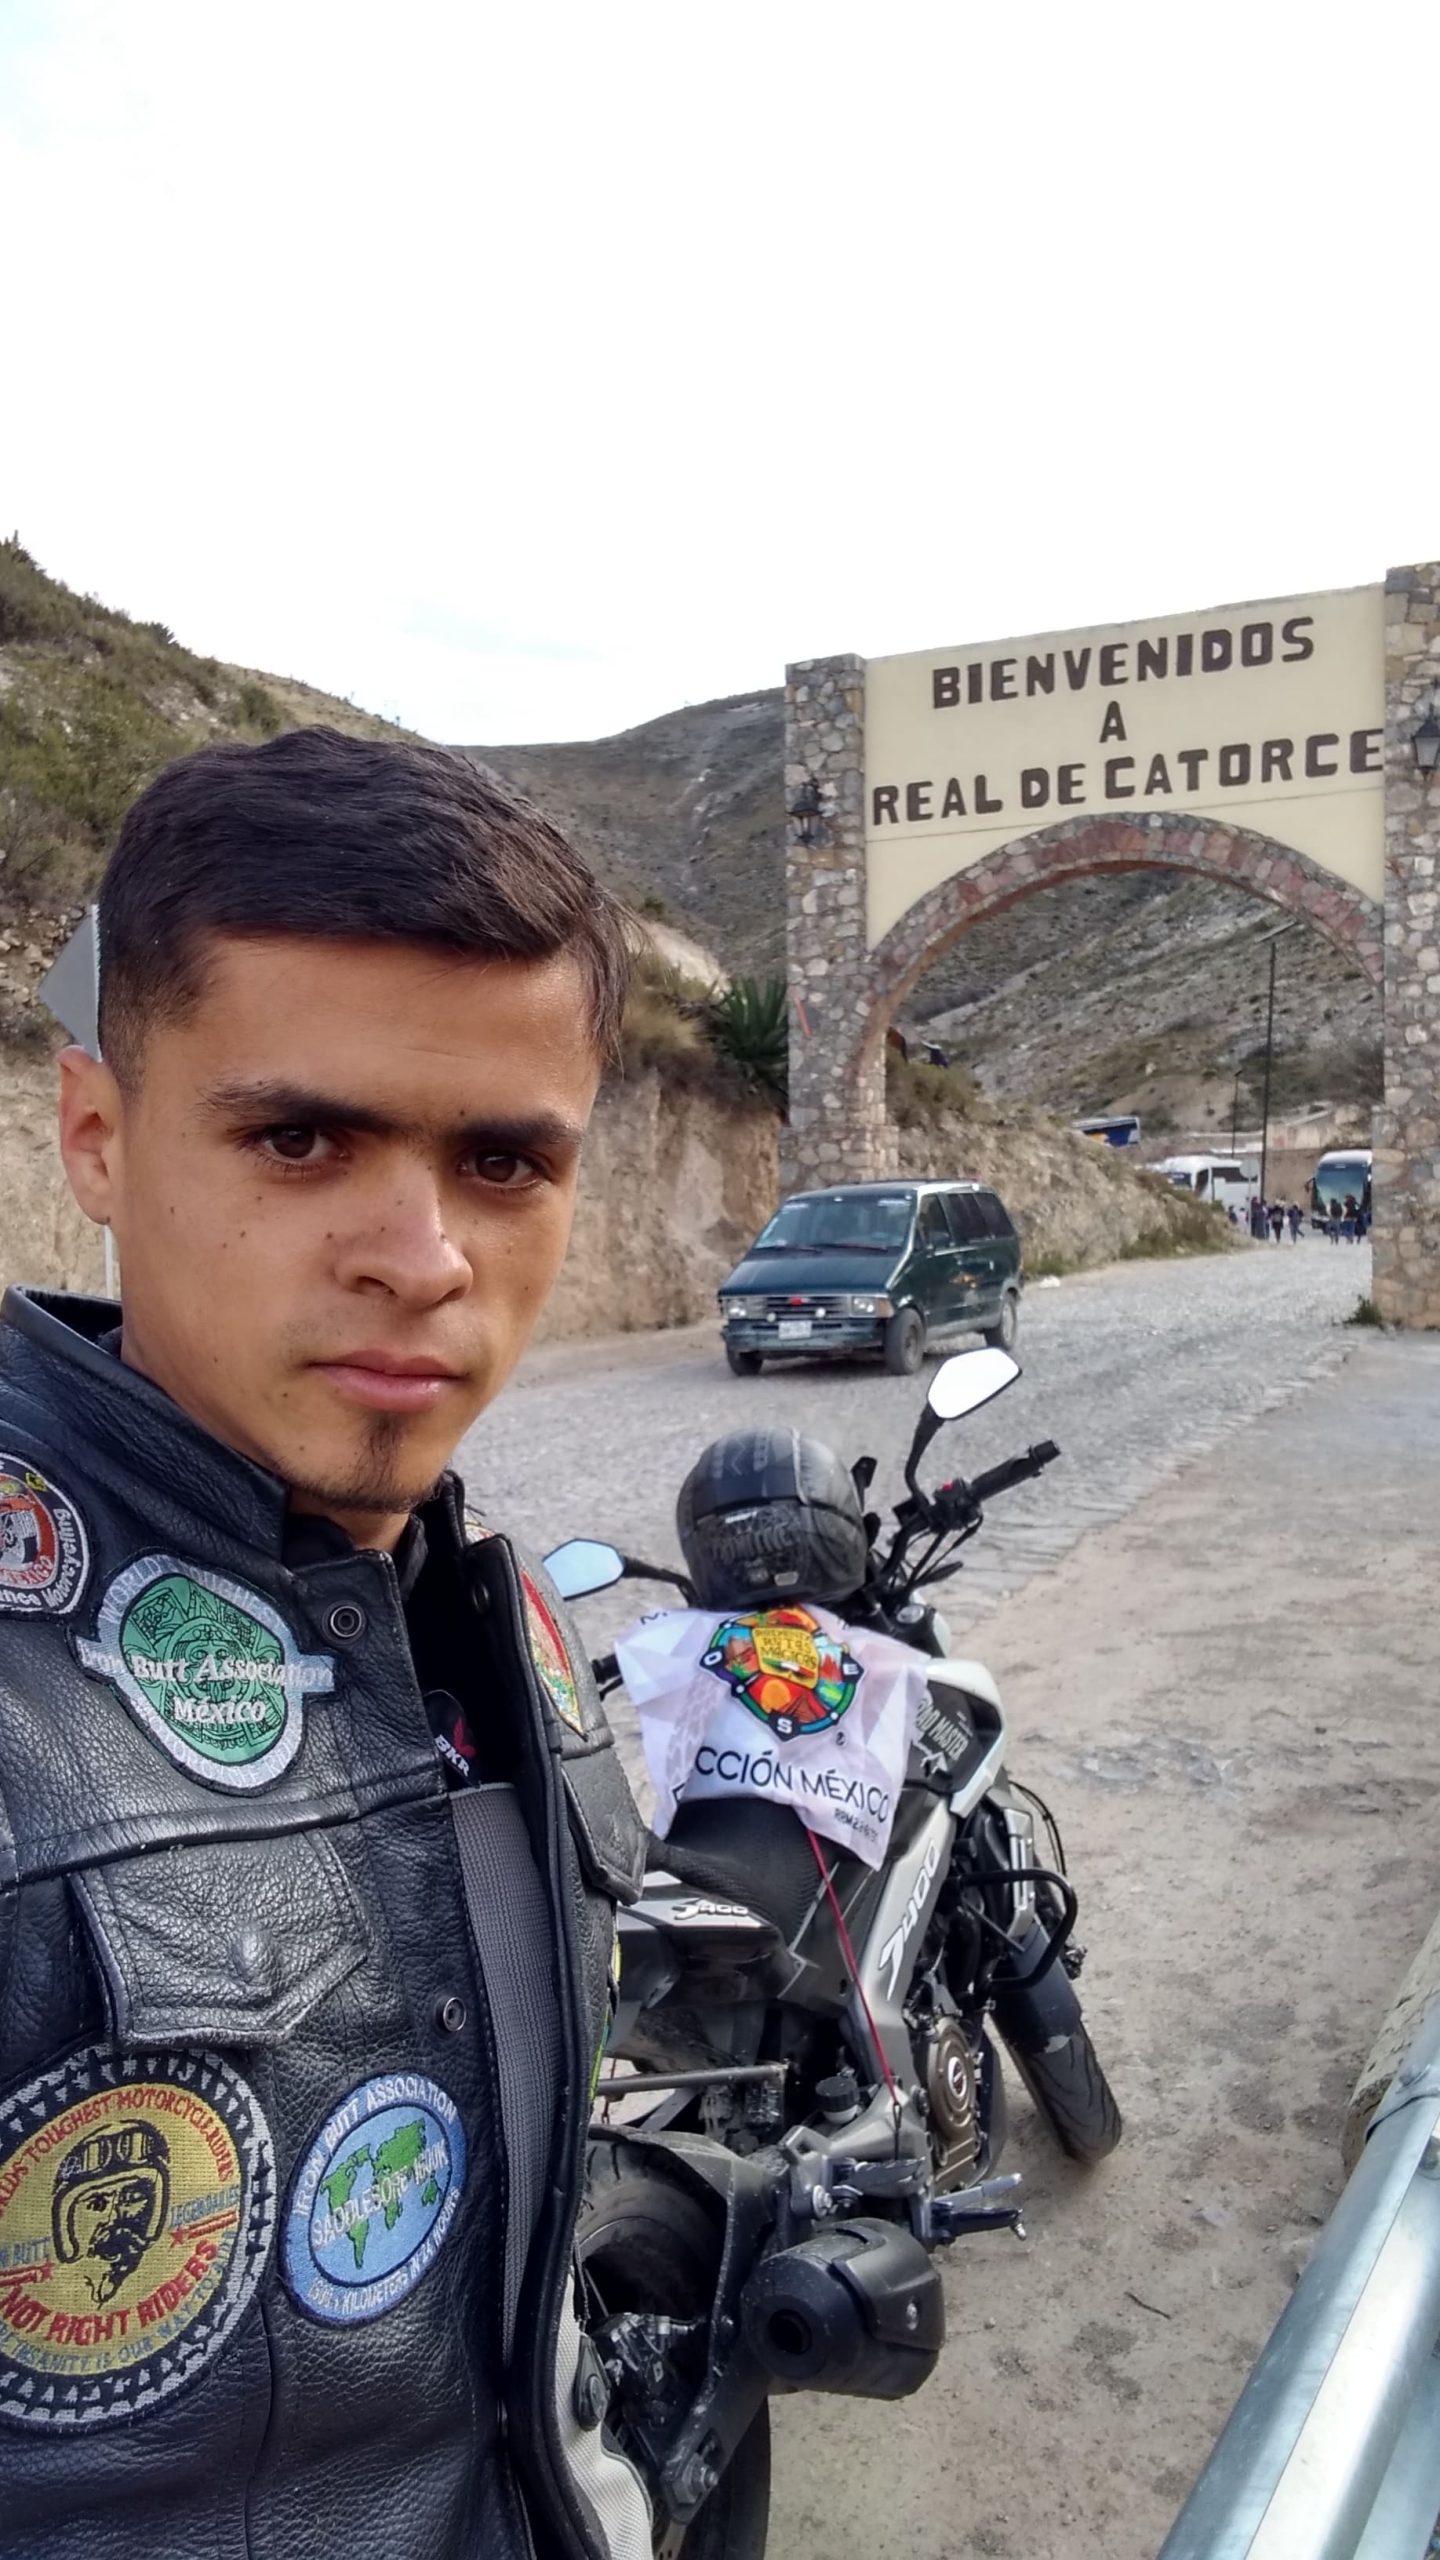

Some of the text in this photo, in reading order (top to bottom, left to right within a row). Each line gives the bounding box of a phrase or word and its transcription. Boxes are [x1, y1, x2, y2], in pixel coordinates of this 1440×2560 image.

[933, 616, 1314, 709] BIENVENIDOS
[1099, 700, 1127, 743] A
[873, 728, 1384, 826] REAL DE CATORCE
[131, 1656, 187, 1682] Butt
[192, 1655, 335, 1687] Association
[173, 1695, 266, 1724] México
[777, 1717, 793, 1734] S
[928, 1716, 970, 1761] MASTER
[800, 1769, 889, 1823] MÉXICO
[24, 2093, 112, 2162] TOUGHEST
[293, 2076, 457, 2218] IRON BUTT ASSOCIATION
[311, 2165, 409, 2247] SADDLESORE
[3, 2286, 50, 2333] NOT
[45, 2309, 132, 2345] RIGHT
[137, 2239, 218, 2328] RIDERS
